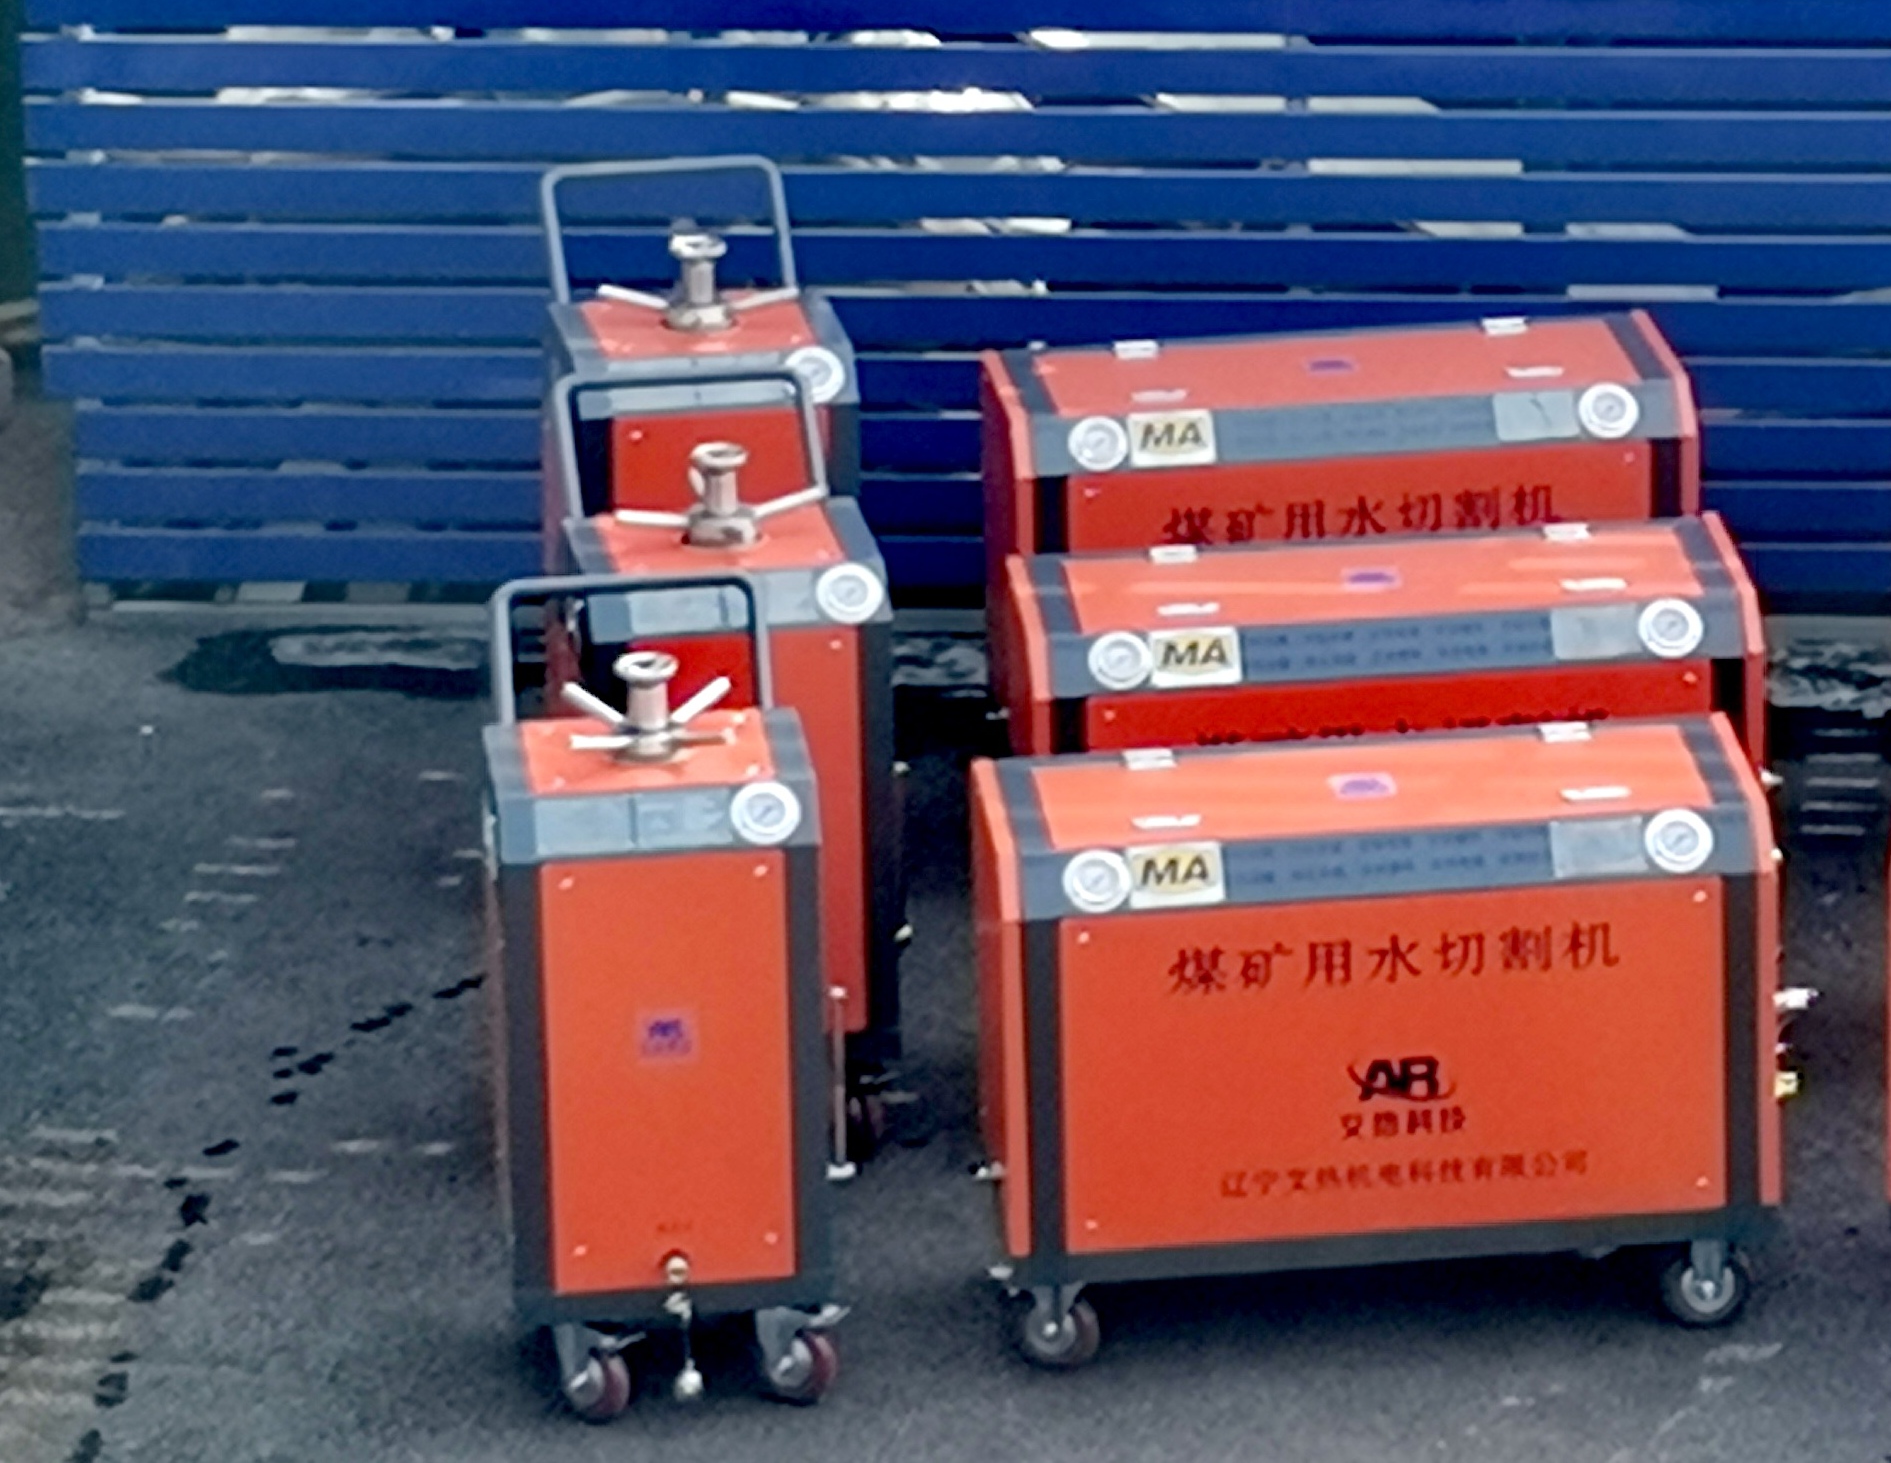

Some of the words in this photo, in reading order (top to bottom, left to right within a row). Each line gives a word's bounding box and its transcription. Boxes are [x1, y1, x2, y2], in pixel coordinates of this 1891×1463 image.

[1139, 413, 1206, 452] MA
[1162, 484, 1563, 545] 煤矿用水切割机
[1157, 634, 1228, 670] MA
[1140, 854, 1211, 888] MA
[1167, 919, 1620, 996] 煤矿用水切割机
